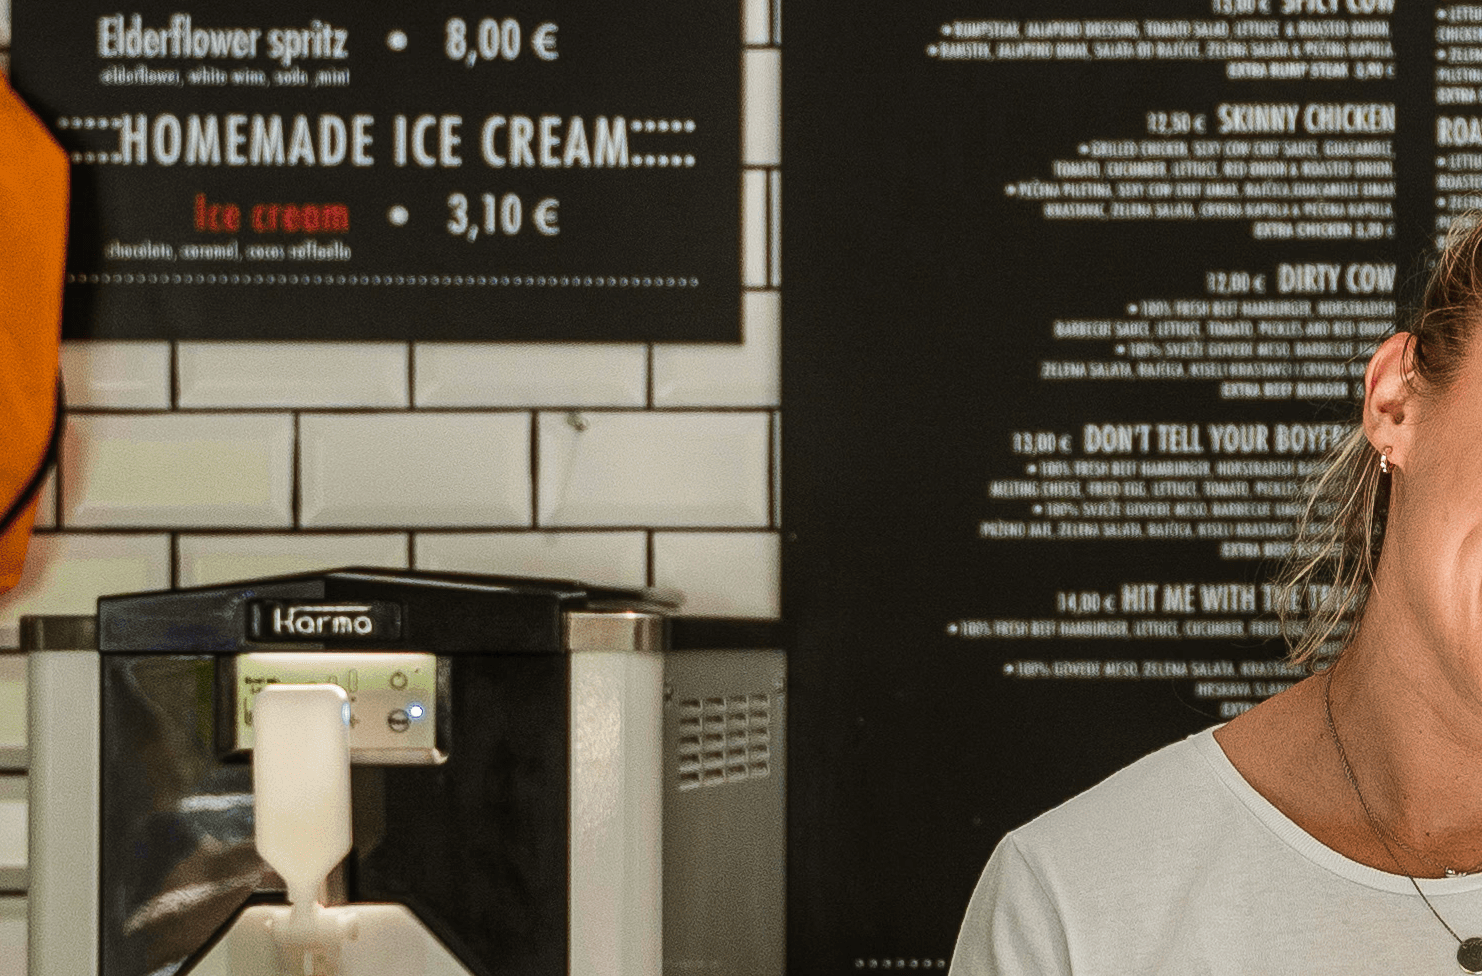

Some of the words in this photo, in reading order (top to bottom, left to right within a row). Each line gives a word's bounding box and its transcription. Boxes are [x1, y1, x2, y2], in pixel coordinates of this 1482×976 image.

[99, 15, 262, 60] Elderflower
[269, 20, 350, 67] spritz
[447, 19, 521, 66] 8,00
[533, 24, 559, 61] €
[1217, 103, 1297, 133] SKINNY
[1304, 103, 1396, 133] CHICKEN
[122, 115, 375, 167] HOMEMADE
[396, 116, 463, 167] ICE
[483, 116, 630, 168] CREAM
[197, 195, 241, 232] Ice
[253, 206, 350, 234] cream
[449, 194, 523, 241] 3,10
[535, 200, 560, 236] €
[1278, 263, 1339, 293] DIRTY
[1346, 263, 1396, 293] COW
[1013, 432, 1056, 456] 13,00
[1157, 423, 1201, 454] TELL
[1210, 423, 1268, 454] YOUR
[1058, 592, 1100, 614] 14,00
[1121, 583, 1156, 614] HIT
[1163, 583, 1193, 614] ME
[1200, 583, 1256, 614] WITH
[274, 605, 374, 636] Karma
